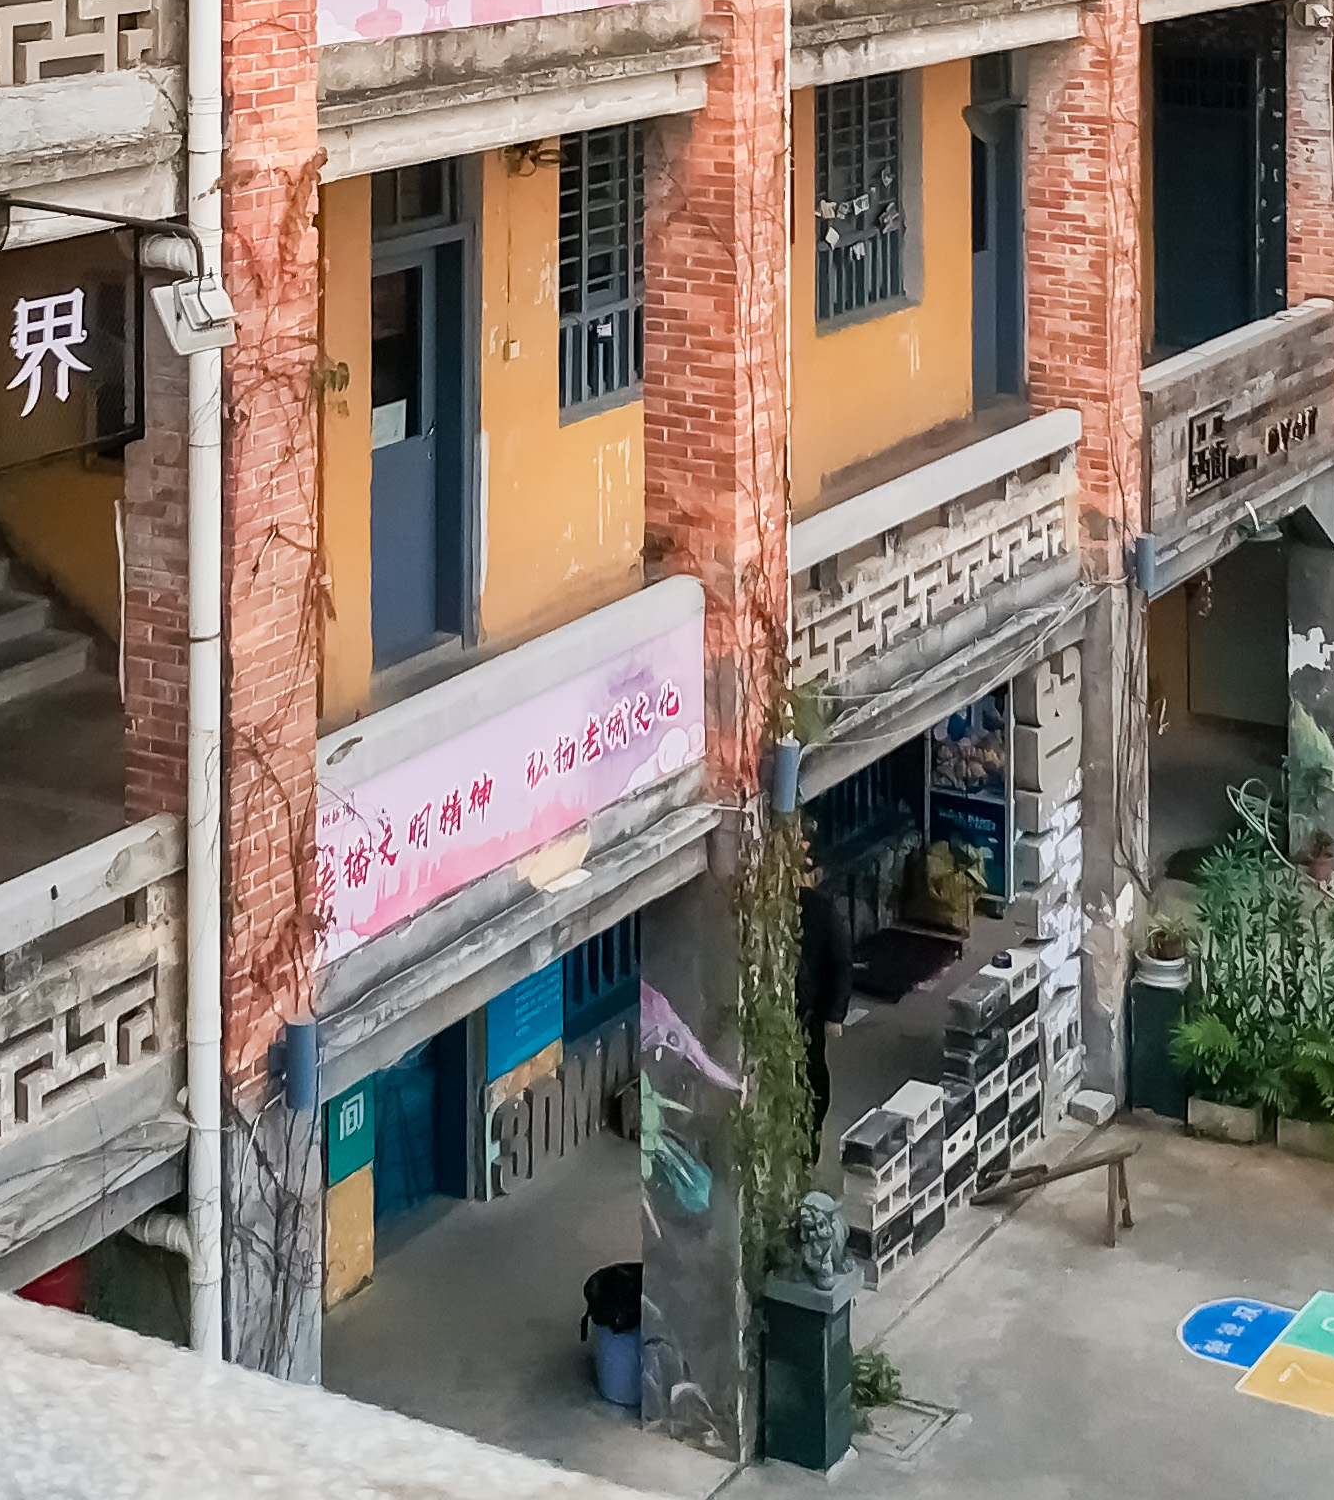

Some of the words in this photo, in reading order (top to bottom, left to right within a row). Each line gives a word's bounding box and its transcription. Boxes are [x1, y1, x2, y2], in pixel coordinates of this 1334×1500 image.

[525, 681, 681, 789] 弘扬老城文化
[1278, 1361, 1334, 1385] 7
